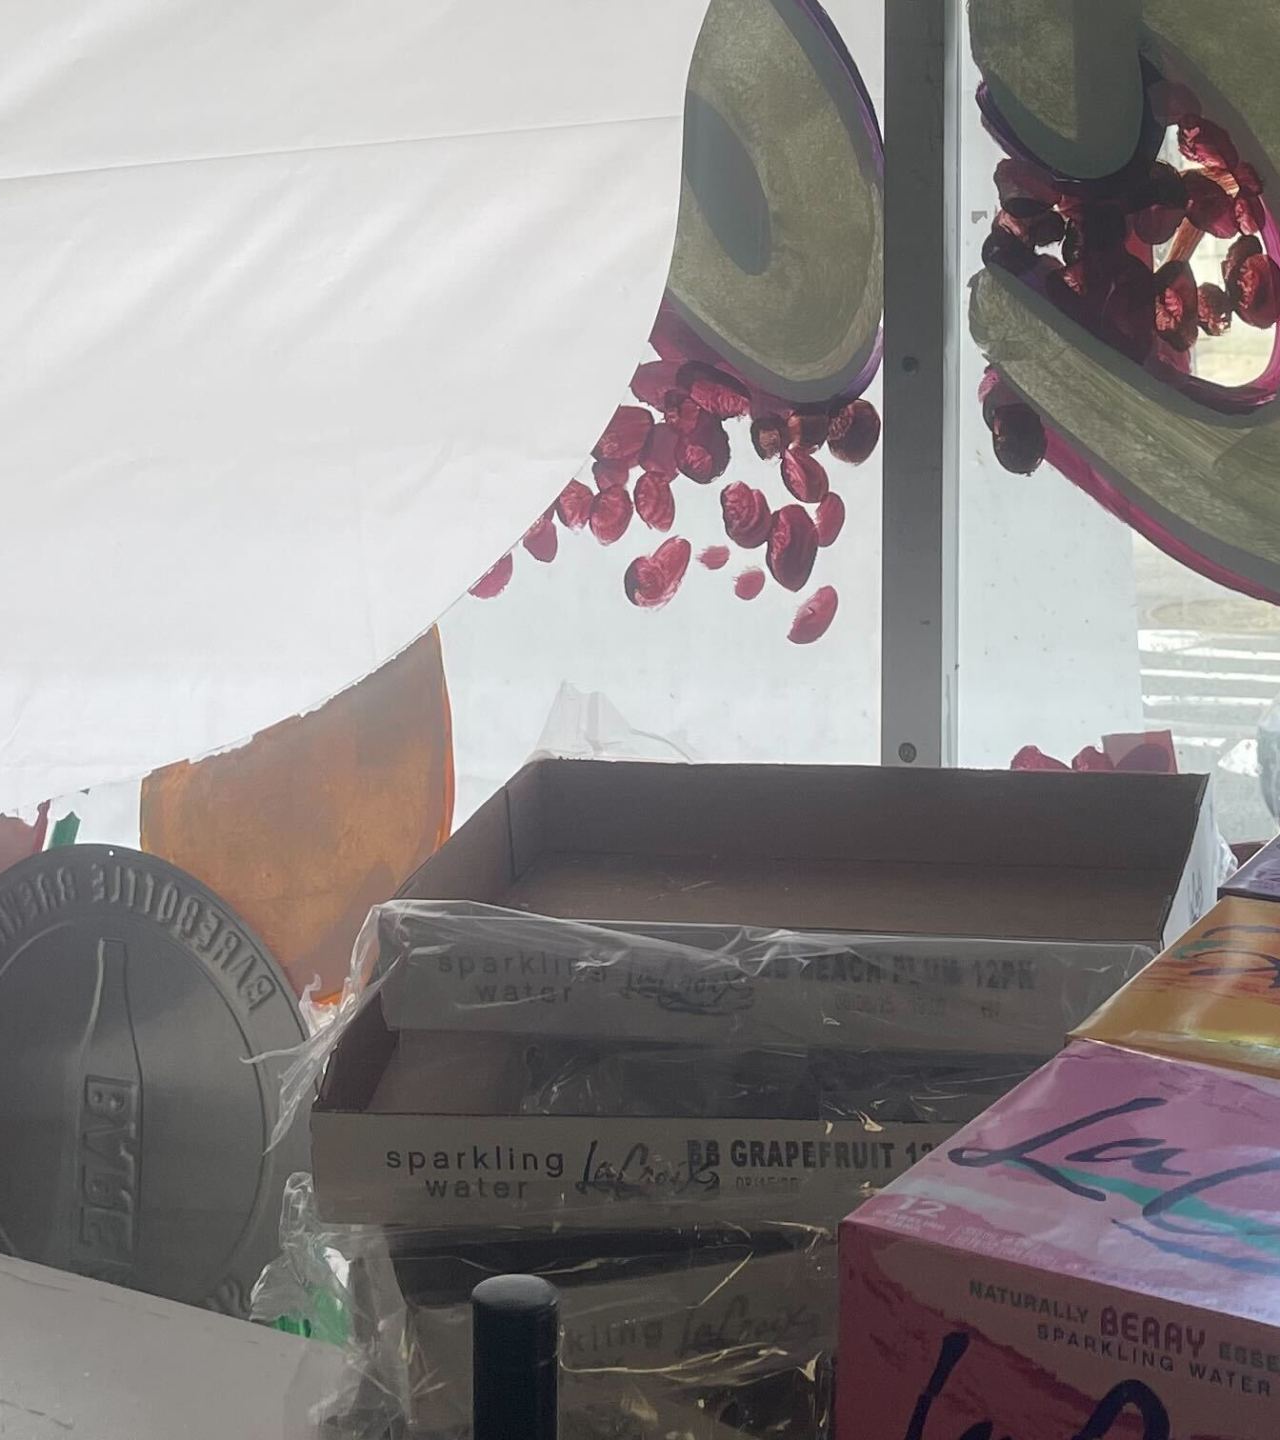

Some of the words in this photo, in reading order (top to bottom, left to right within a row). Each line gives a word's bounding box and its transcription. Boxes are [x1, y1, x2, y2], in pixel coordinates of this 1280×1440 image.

[386, 1144, 566, 1178] sparkling
[729, 1139, 896, 1170] GRAPEFRUIT
[904, 1142, 936, 1169] 12
[425, 1174, 530, 1201] water
[968, 1279, 1090, 1326] NATURALLY
[1099, 1304, 1207, 1359] BERRY
[1036, 1322, 1176, 1374] SPARKLING
[1187, 1360, 1273, 1399] WATER
